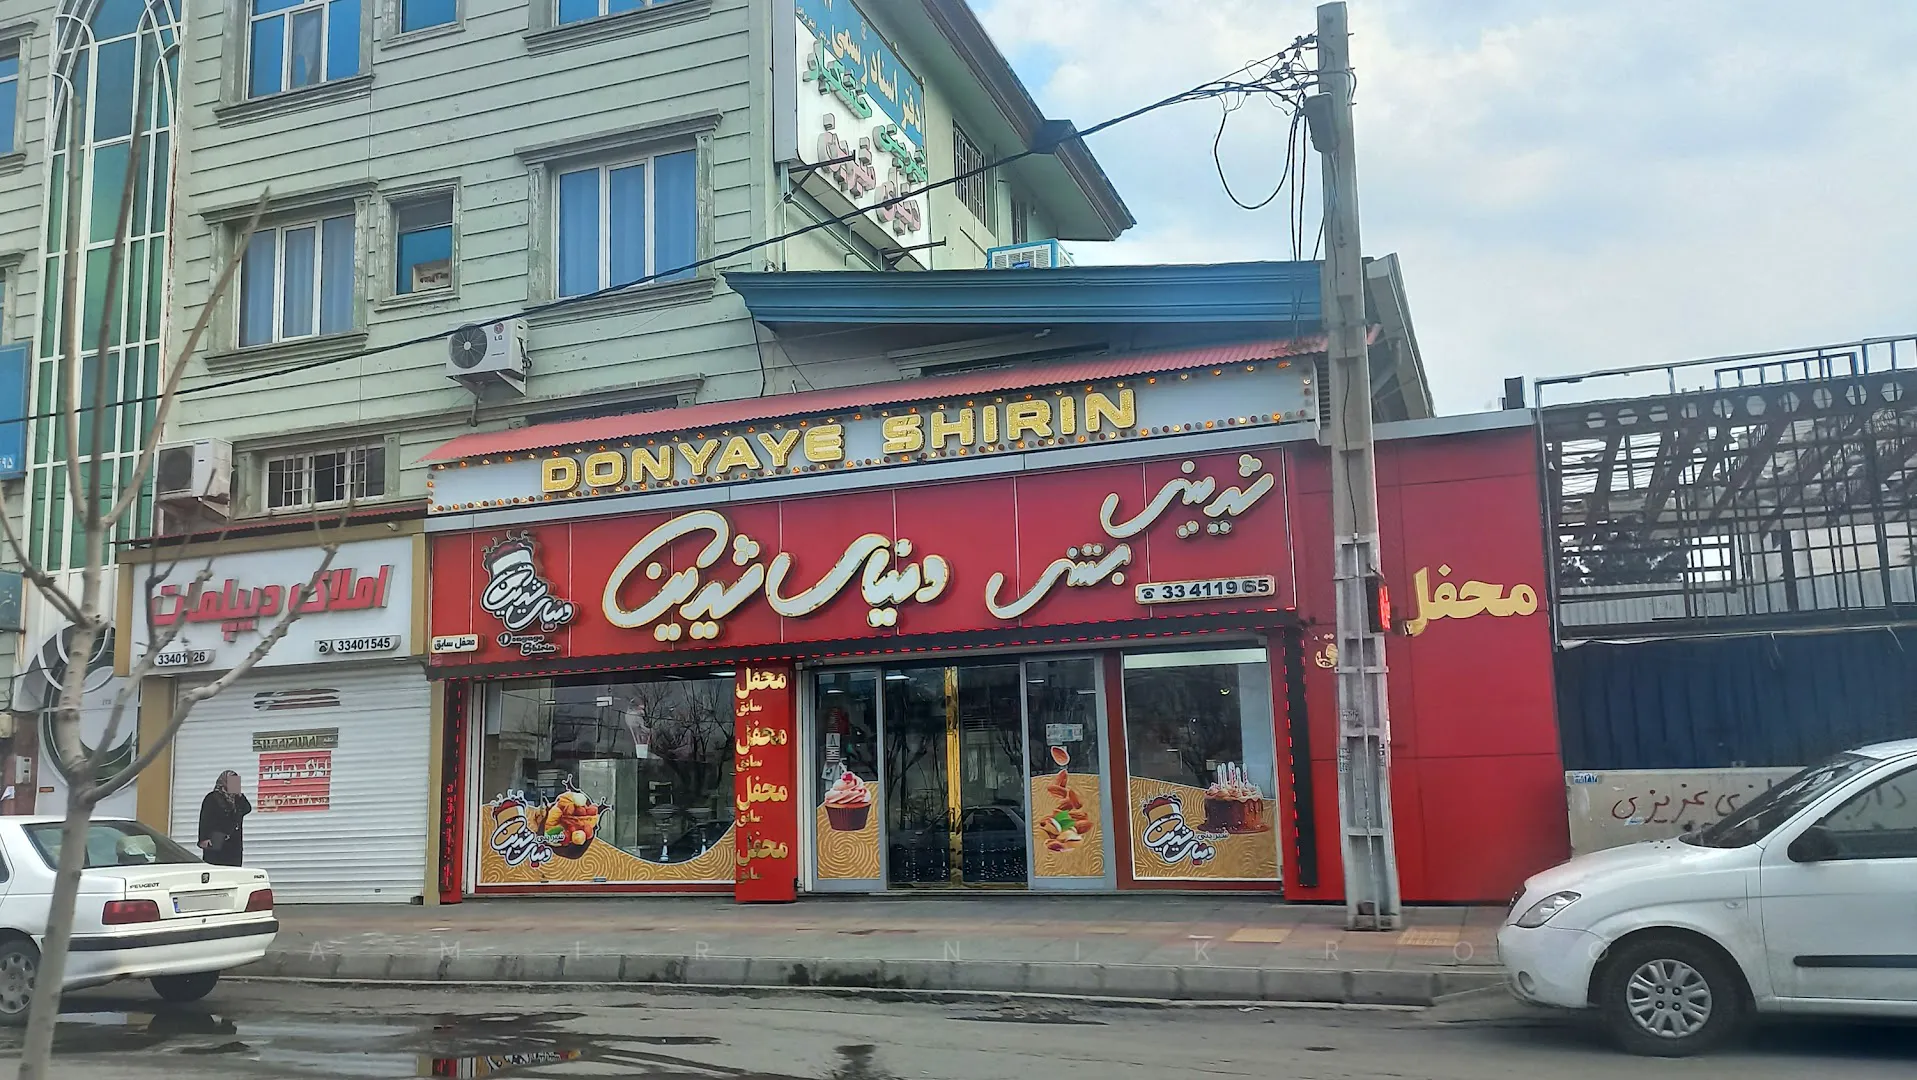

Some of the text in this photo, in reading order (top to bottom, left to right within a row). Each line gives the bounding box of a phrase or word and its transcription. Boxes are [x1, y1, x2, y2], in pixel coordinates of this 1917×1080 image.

[541, 388, 1137, 493] DONYAYE SHIRIN
[1099, 453, 1276, 540] شیرینی
[288, 564, 394, 614] املاک
[603, 509, 950, 641] دنیای شیرین
[986, 542, 1134, 620] بستنی
[1404, 564, 1539, 637] محفل
[157, 650, 206, 665] 3340126
[337, 637, 391, 652] 33401545
[434, 636, 476, 651] محفل سابق
[735, 667, 788, 699] محفل
[735, 698, 763, 716] سابق
[735, 720, 788, 754] محفل
[735, 775, 788, 811] محفل
[1612, 784, 1709, 825] عزیزی
[735, 809, 763, 828] سابق
[735, 831, 788, 867] محفل
[129, 882, 161, 890] PEUGEOT
[735, 866, 763, 884] سابق
